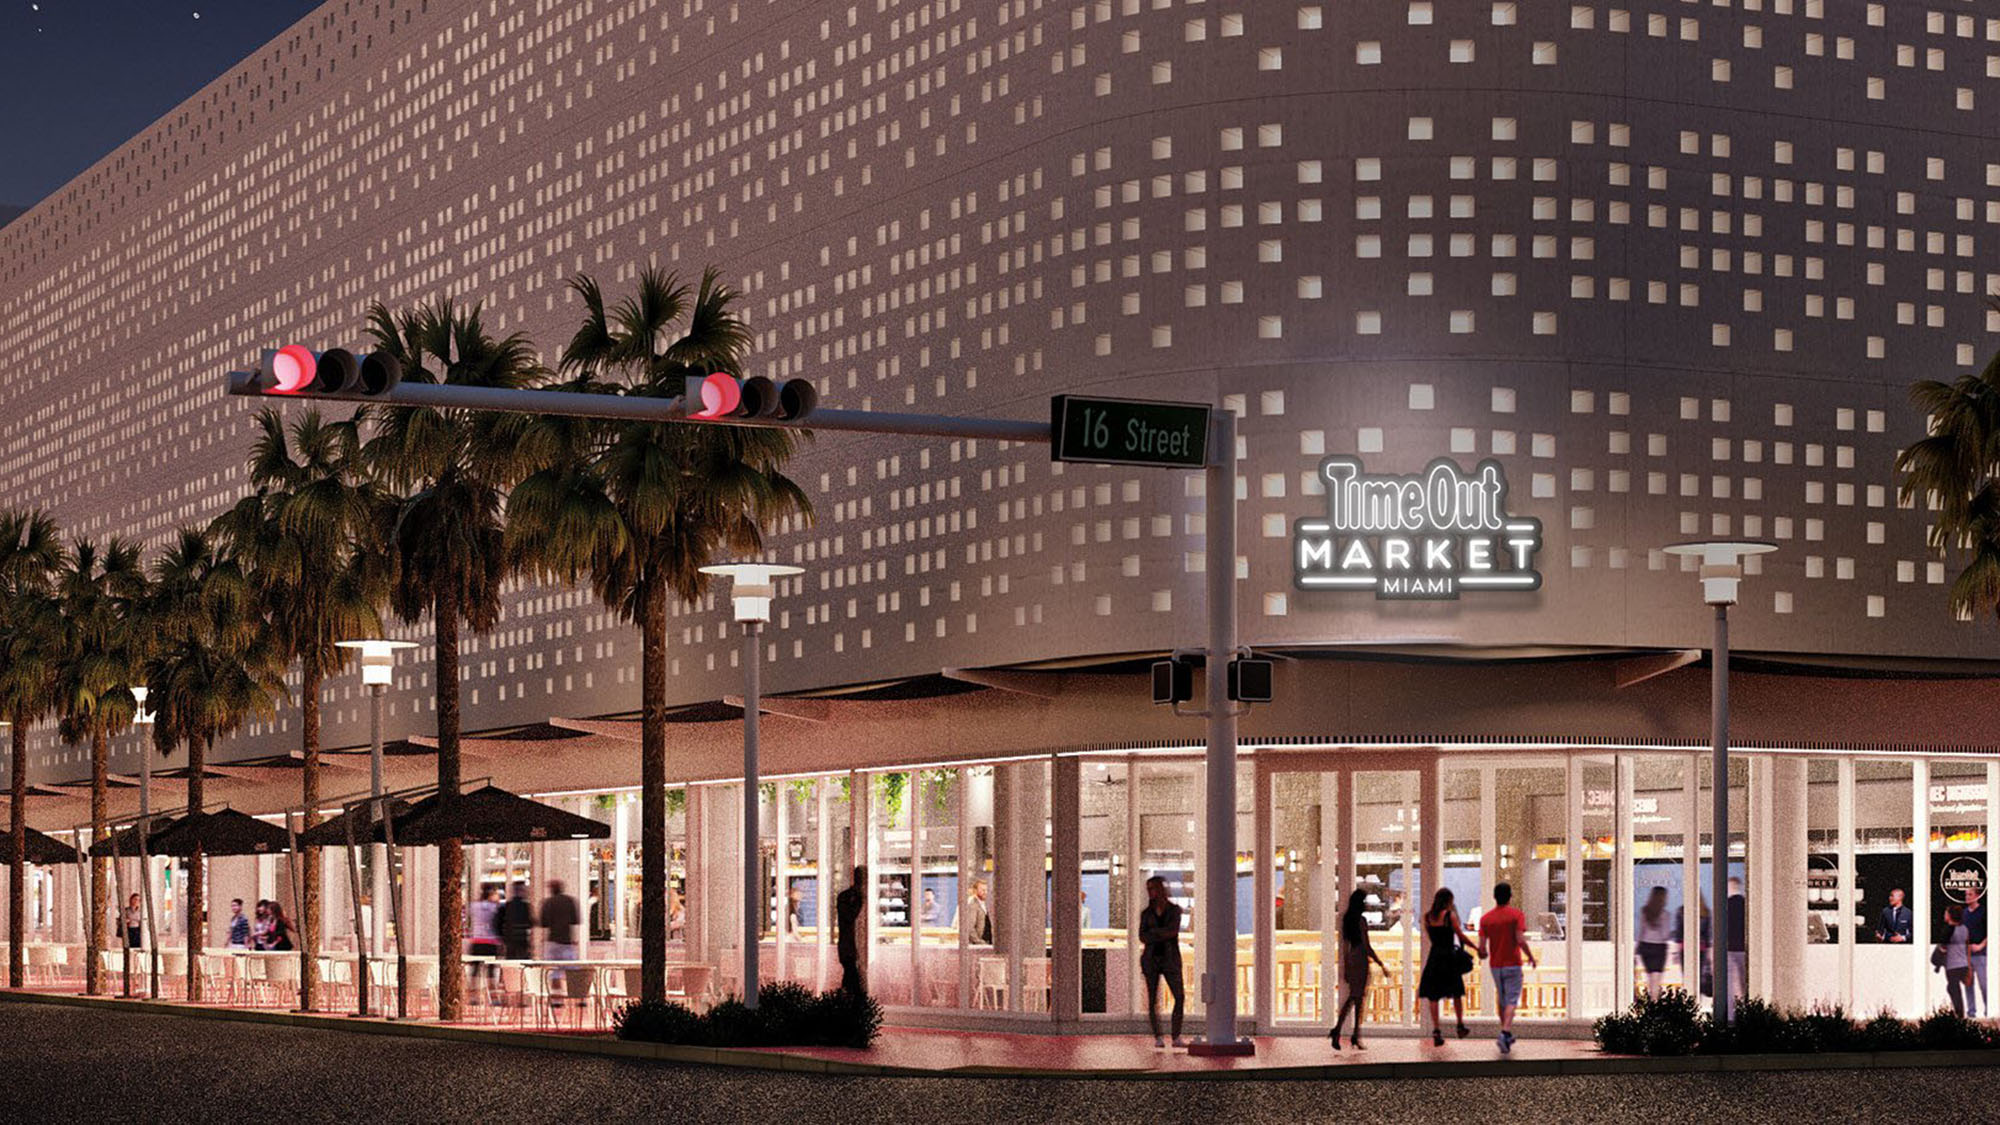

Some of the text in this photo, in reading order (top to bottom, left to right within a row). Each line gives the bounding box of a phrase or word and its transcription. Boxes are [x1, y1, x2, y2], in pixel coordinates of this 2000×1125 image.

[1083, 407, 1190, 456] 16 Street
[1301, 539, 1534, 569] MARKET
[1383, 577, 1452, 593] MIAMI
